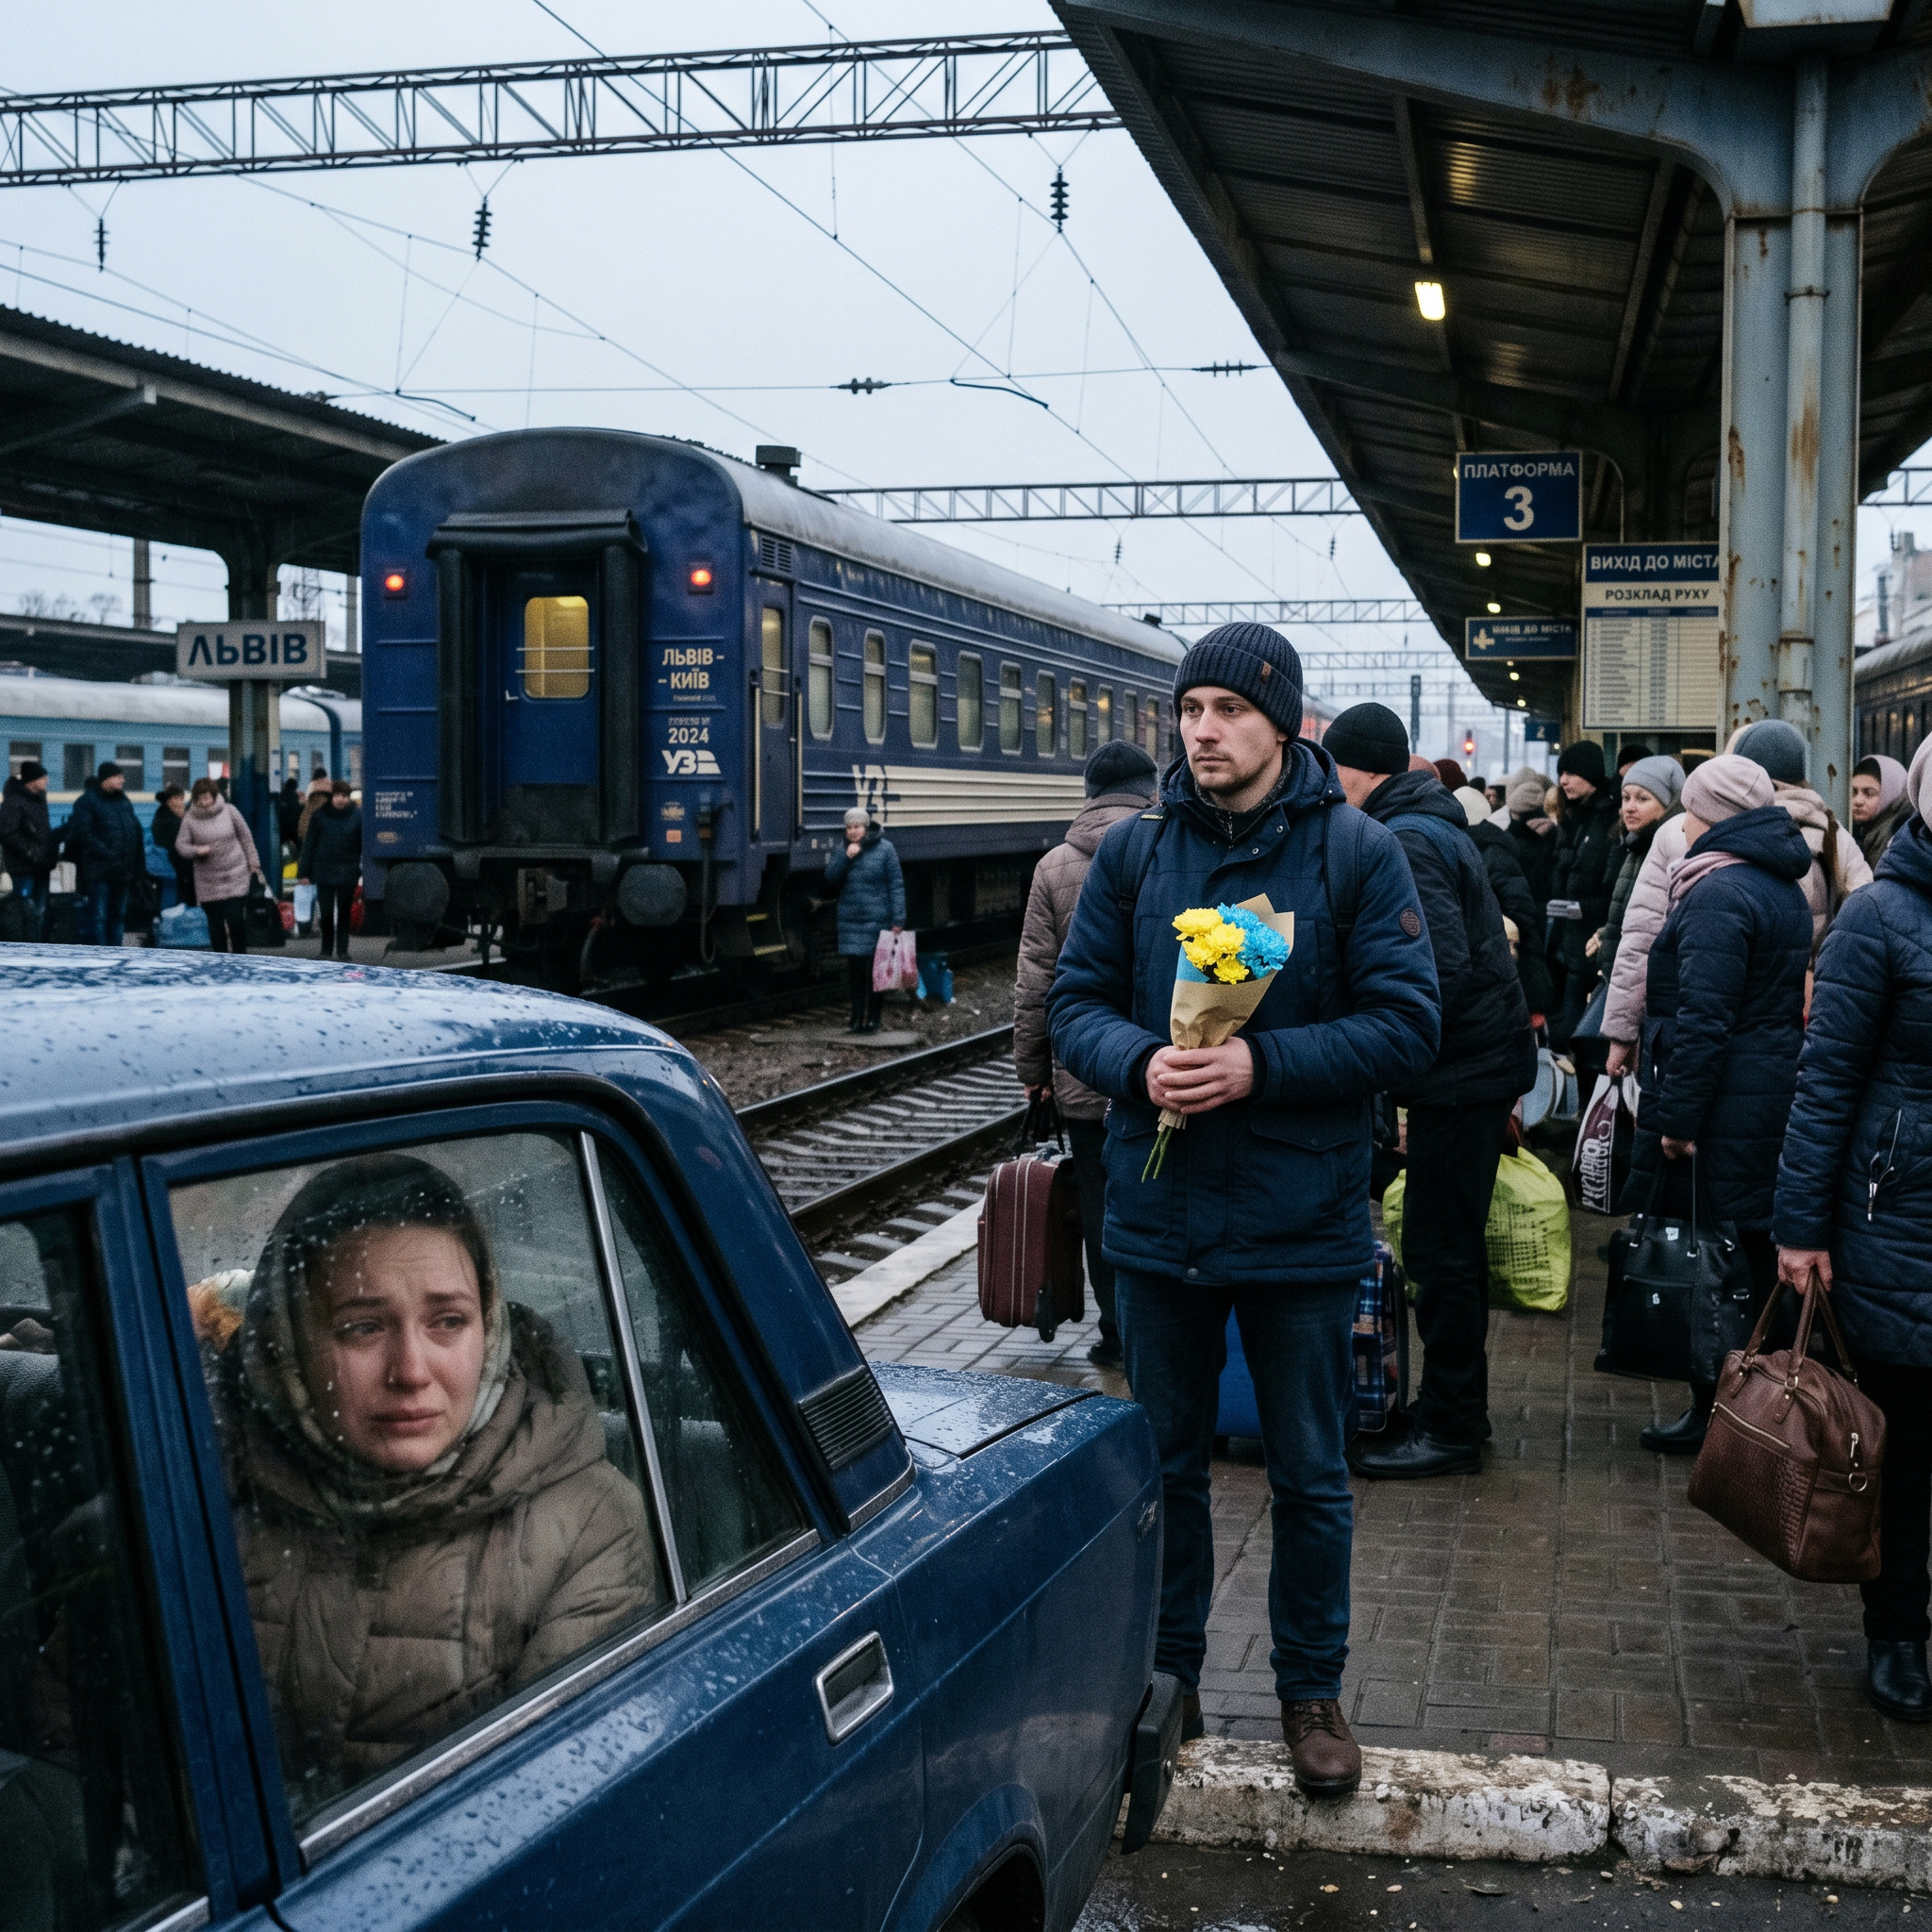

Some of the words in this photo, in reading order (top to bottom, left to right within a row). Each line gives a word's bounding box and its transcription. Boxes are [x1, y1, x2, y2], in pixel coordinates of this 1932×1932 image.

[1464, 462, 1574, 478] ПЛАТФОРМА
[1504, 486, 1535, 531] 3
[1591, 555, 1641, 572] ВИХІД
[1644, 555, 1670, 572] ДО
[1606, 589, 1671, 602] РОЗКЛАД
[1674, 589, 1709, 600] РУХУ
[190, 633, 308, 666] ЛЬВІВ
[668, 727, 709, 744] 2024
